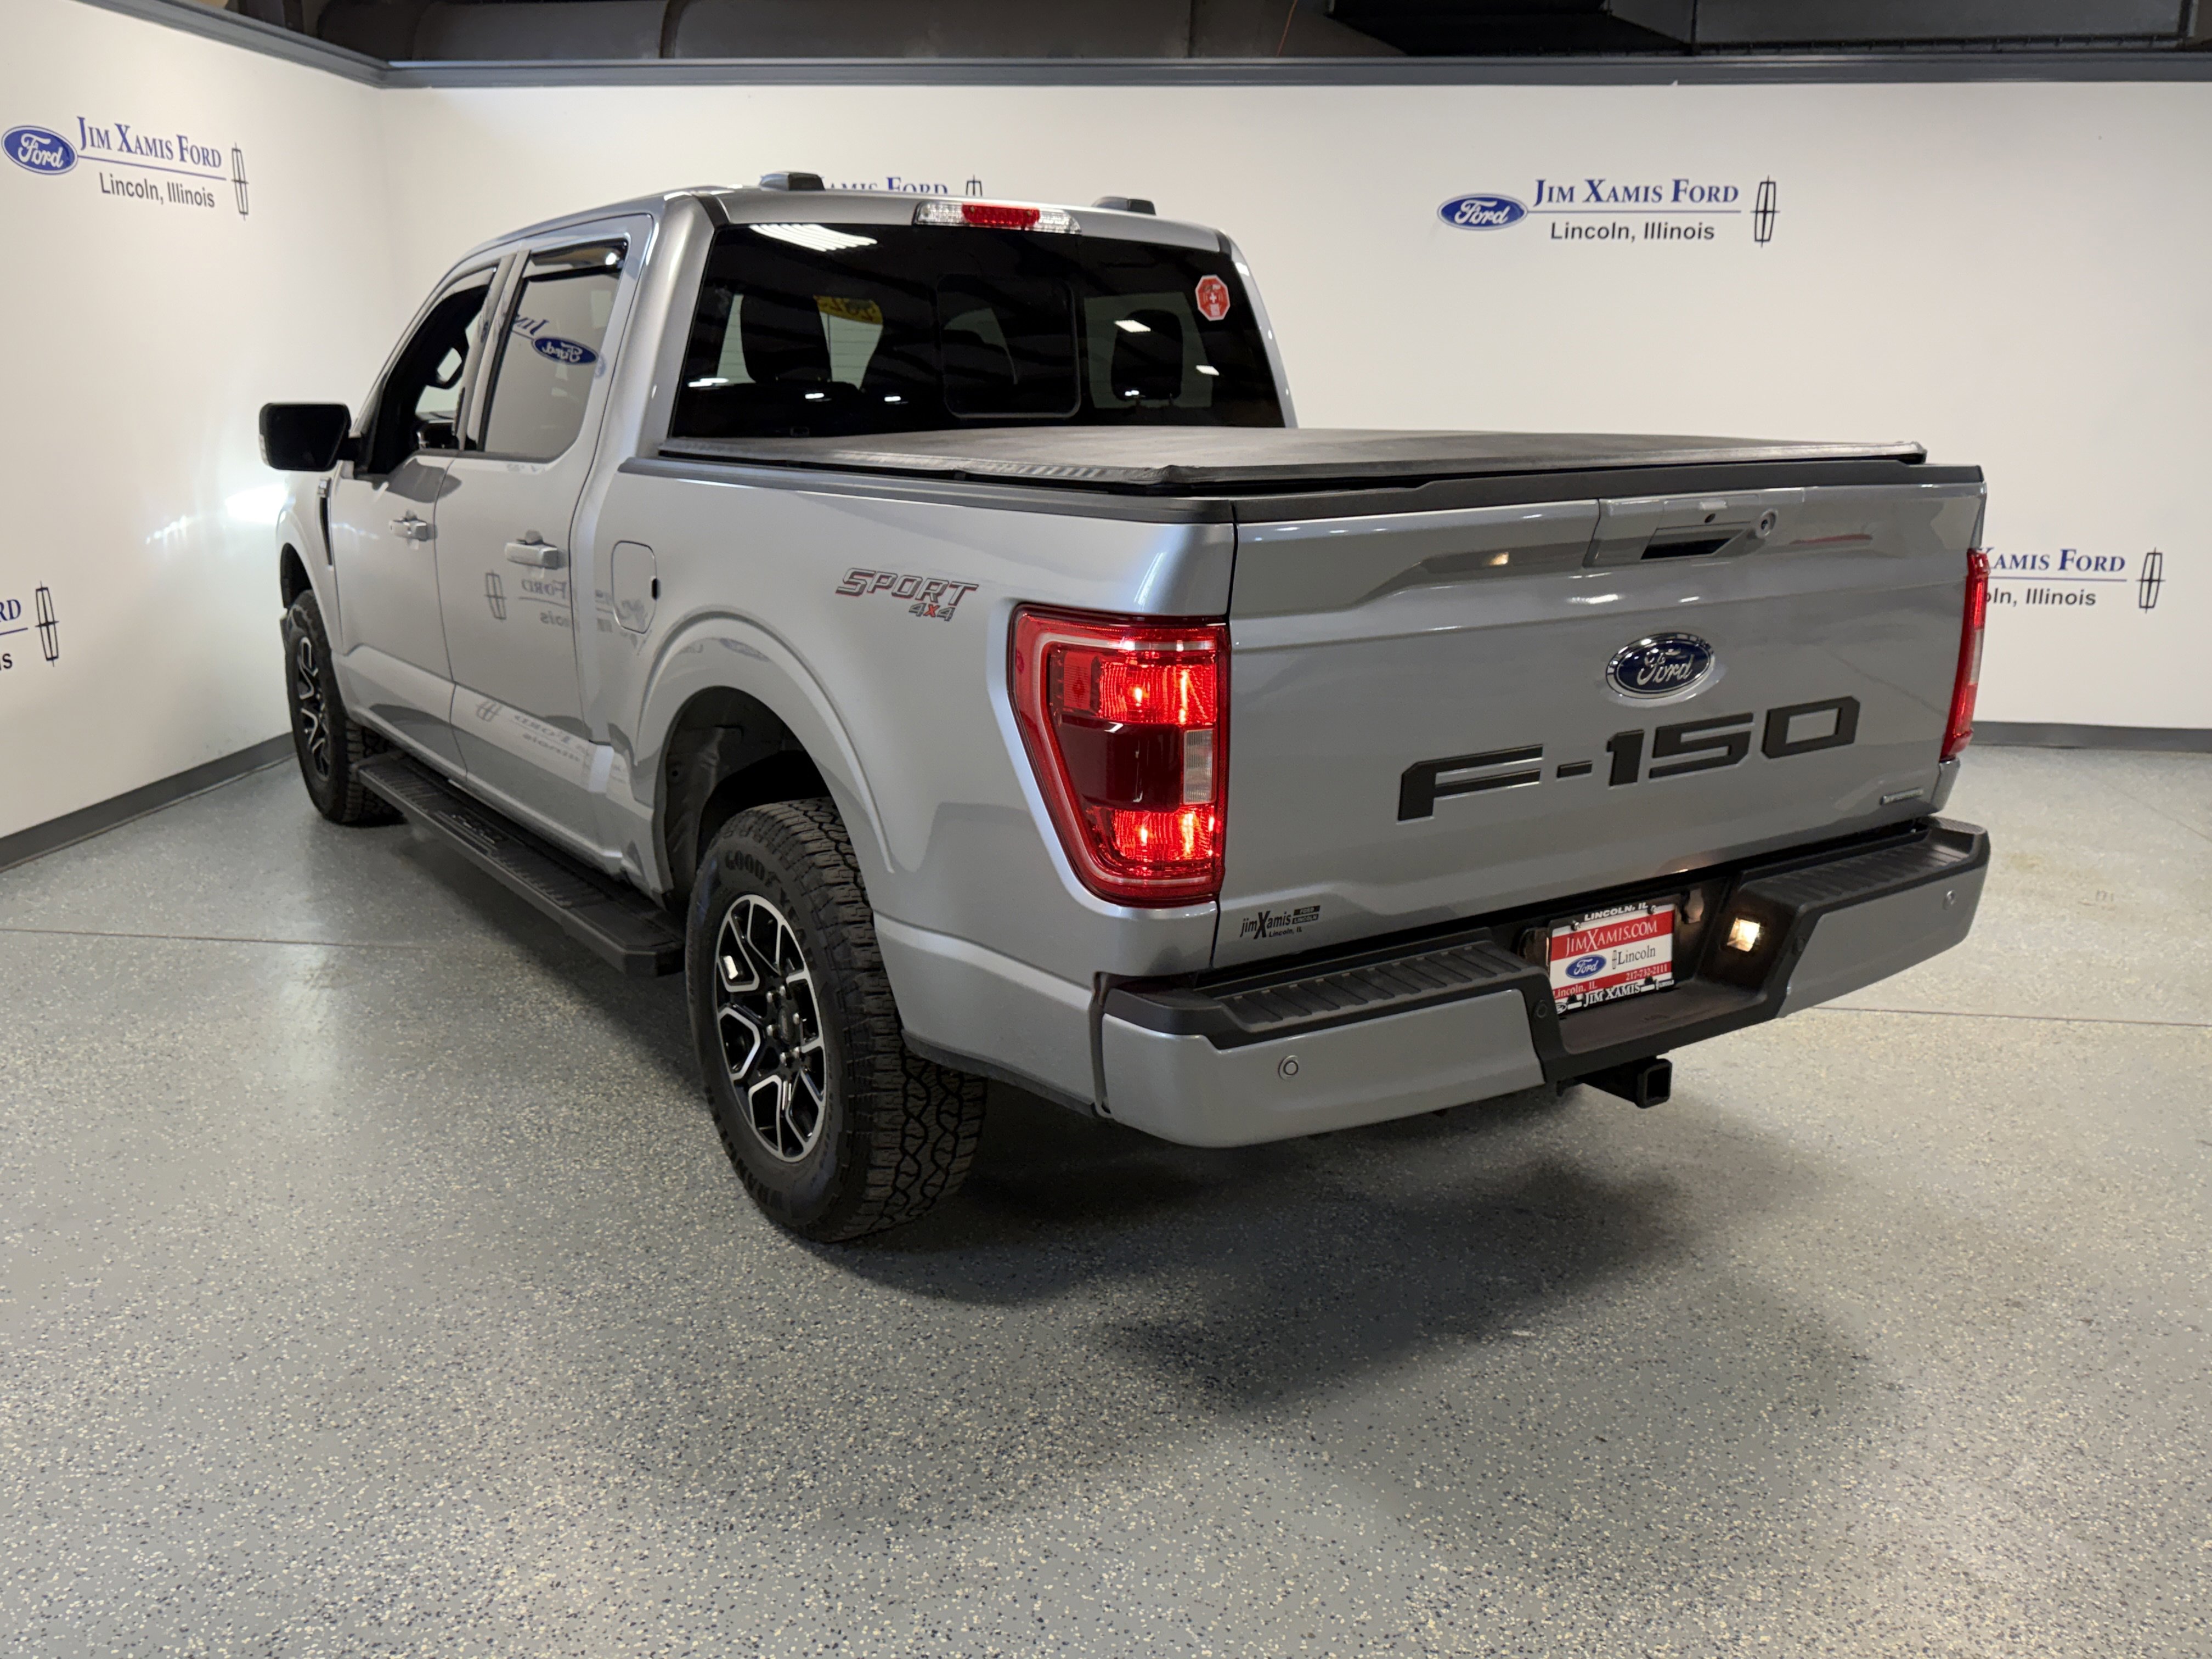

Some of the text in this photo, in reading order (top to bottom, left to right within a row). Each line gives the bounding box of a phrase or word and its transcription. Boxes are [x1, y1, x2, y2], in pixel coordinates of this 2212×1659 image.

[18, 133, 64, 168] Ford
[77, 116, 222, 168] JIM XAMIS FORD
[99, 172, 215, 208] Lincoln, Illinois
[1533, 178, 1739, 207] JIM XAMIS FORD
[1454, 198, 1511, 225] Ford
[1550, 221, 1715, 243] Lincoln, Illinois
[2057, 548, 2125, 572] FORD
[836, 567, 979, 606] SPORT
[2026, 588, 2097, 606] Illinois
[1637, 648, 1692, 684] Ford
[1397, 696, 1860, 822] F-150
[1584, 905, 1635, 922] LINCOLN,
[1566, 920, 1658, 956] JIMXAMIS.COM
[1573, 957, 1599, 975] Ford
[1618, 945, 1656, 965] Lincoln
[1626, 963, 1668, 981] 217-732-2111
[1583, 991, 1604, 1007] JIM
[1605, 982, 1641, 1001] XAMIS
[1588, 981, 1598, 990] IL
